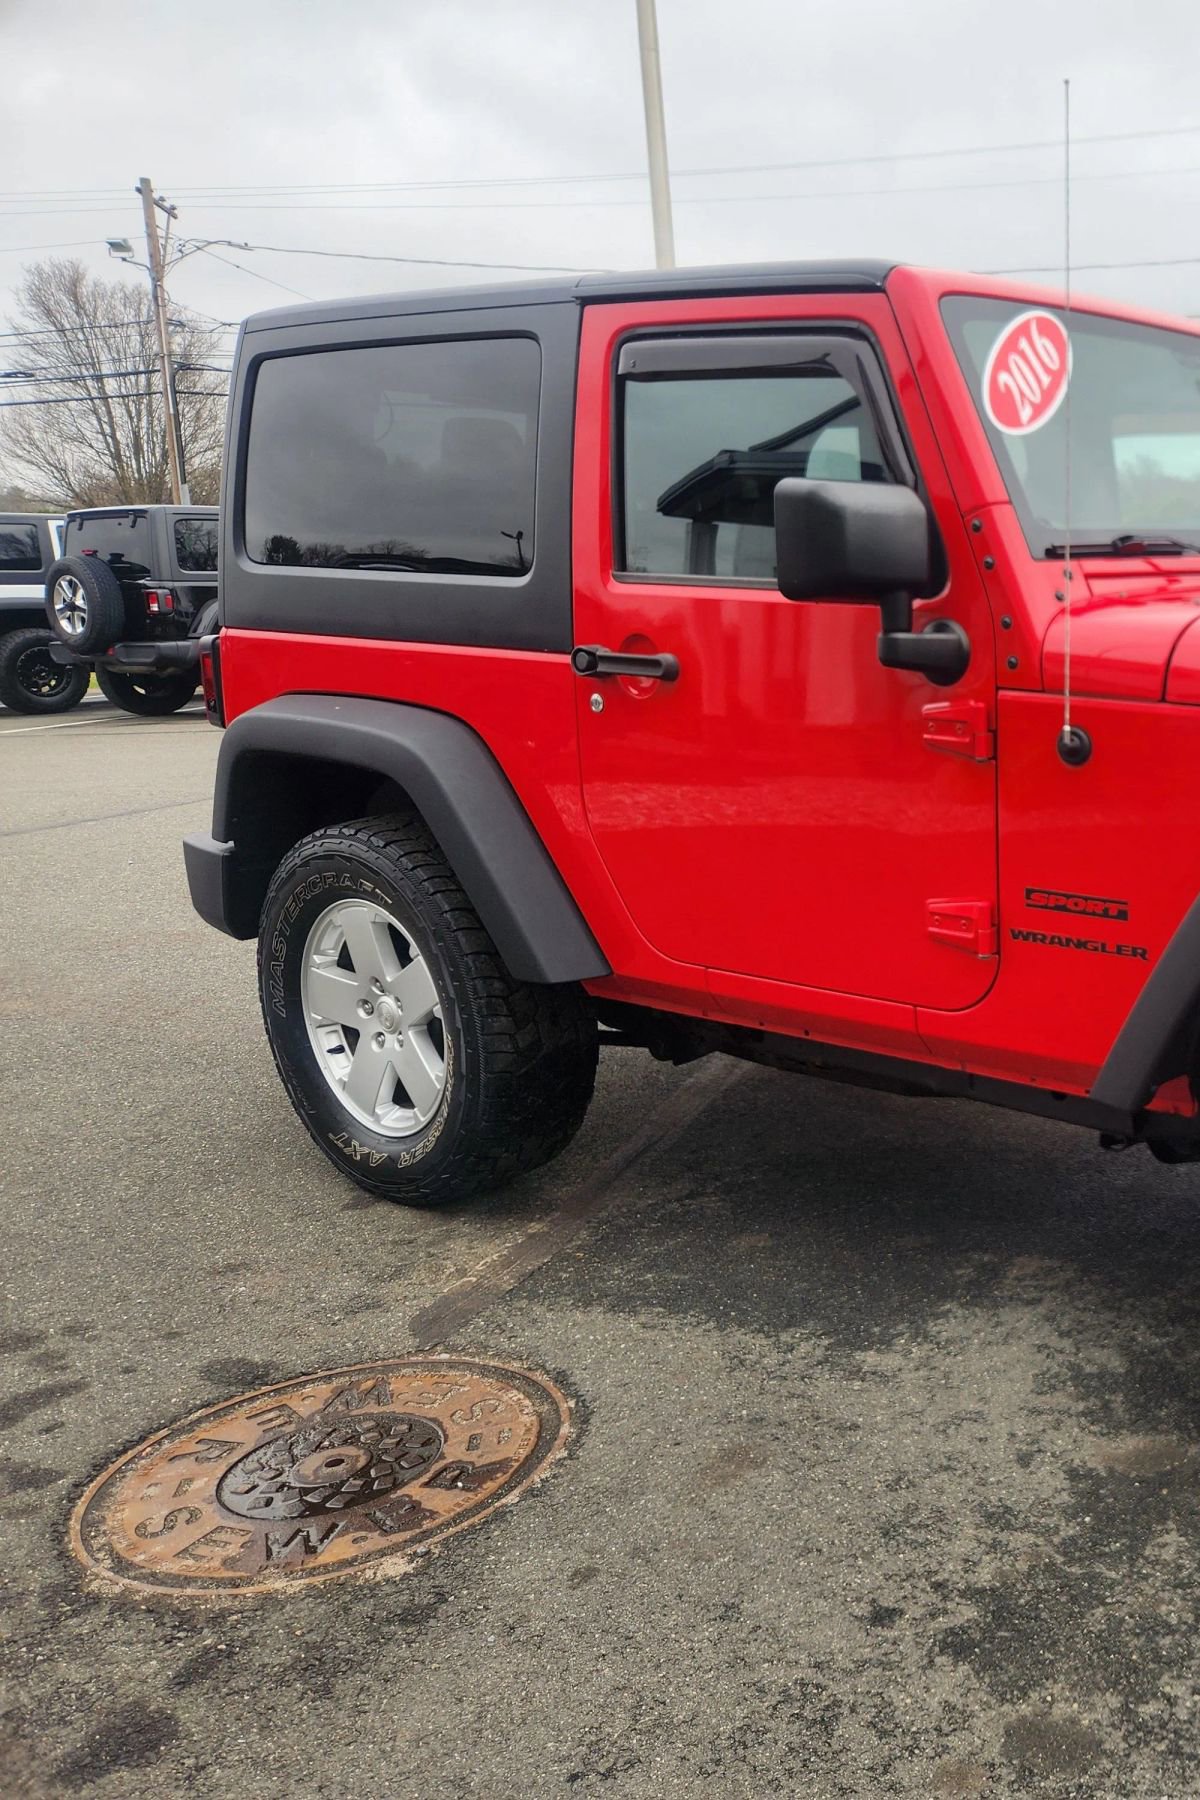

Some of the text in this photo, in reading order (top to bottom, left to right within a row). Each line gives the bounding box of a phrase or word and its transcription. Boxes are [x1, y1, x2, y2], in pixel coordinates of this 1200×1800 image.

[997, 318, 1060, 426] 2016
[1026, 889, 1129, 919] SPORT
[271, 872, 393, 1018] MASTERCRAFT
[1009, 928, 1149, 960] WRANGLER
[327, 1131, 389, 1167] AXT
[134, 1462, 508, 1563] SEWER
